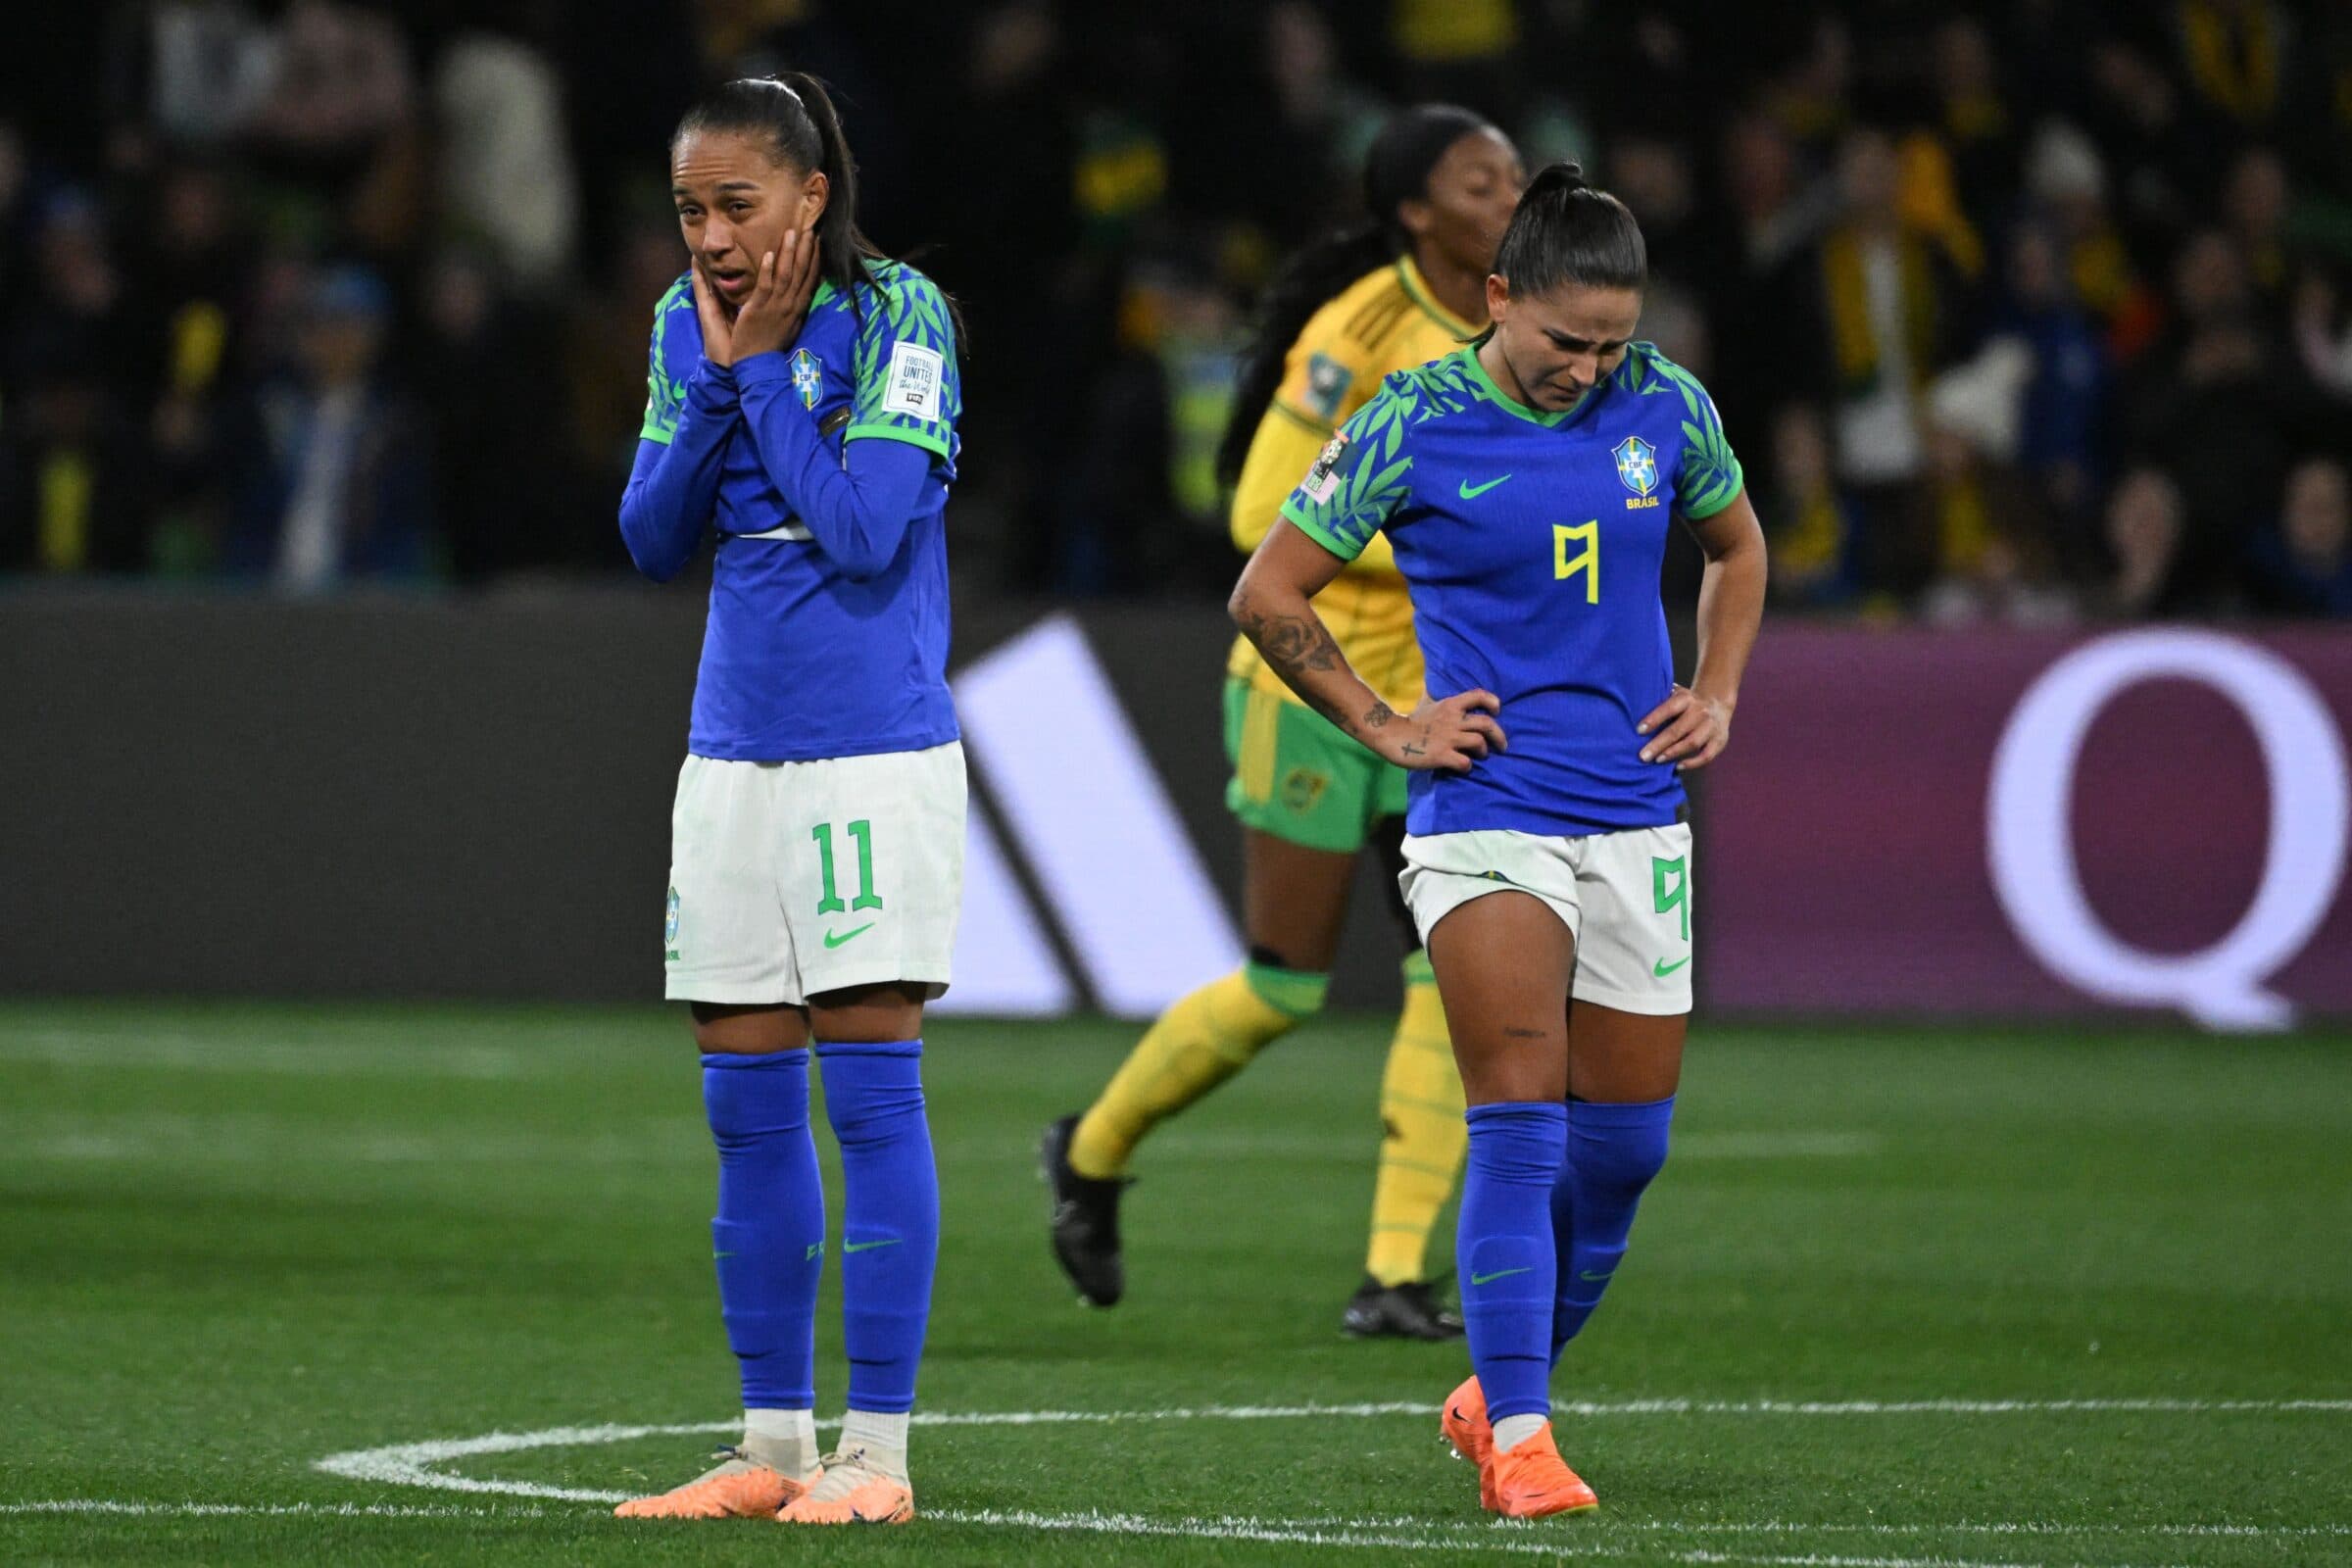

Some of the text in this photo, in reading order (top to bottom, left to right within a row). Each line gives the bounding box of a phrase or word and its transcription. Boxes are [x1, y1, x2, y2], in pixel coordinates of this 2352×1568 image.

[904, 366, 932, 384] UNITES
[1626, 496, 1659, 510] BRASIL
[1552, 519, 1598, 604] 9
[812, 820, 882, 915] 11
[1987, 627, 2350, 1031] Q
[1652, 855, 1688, 941] 9
